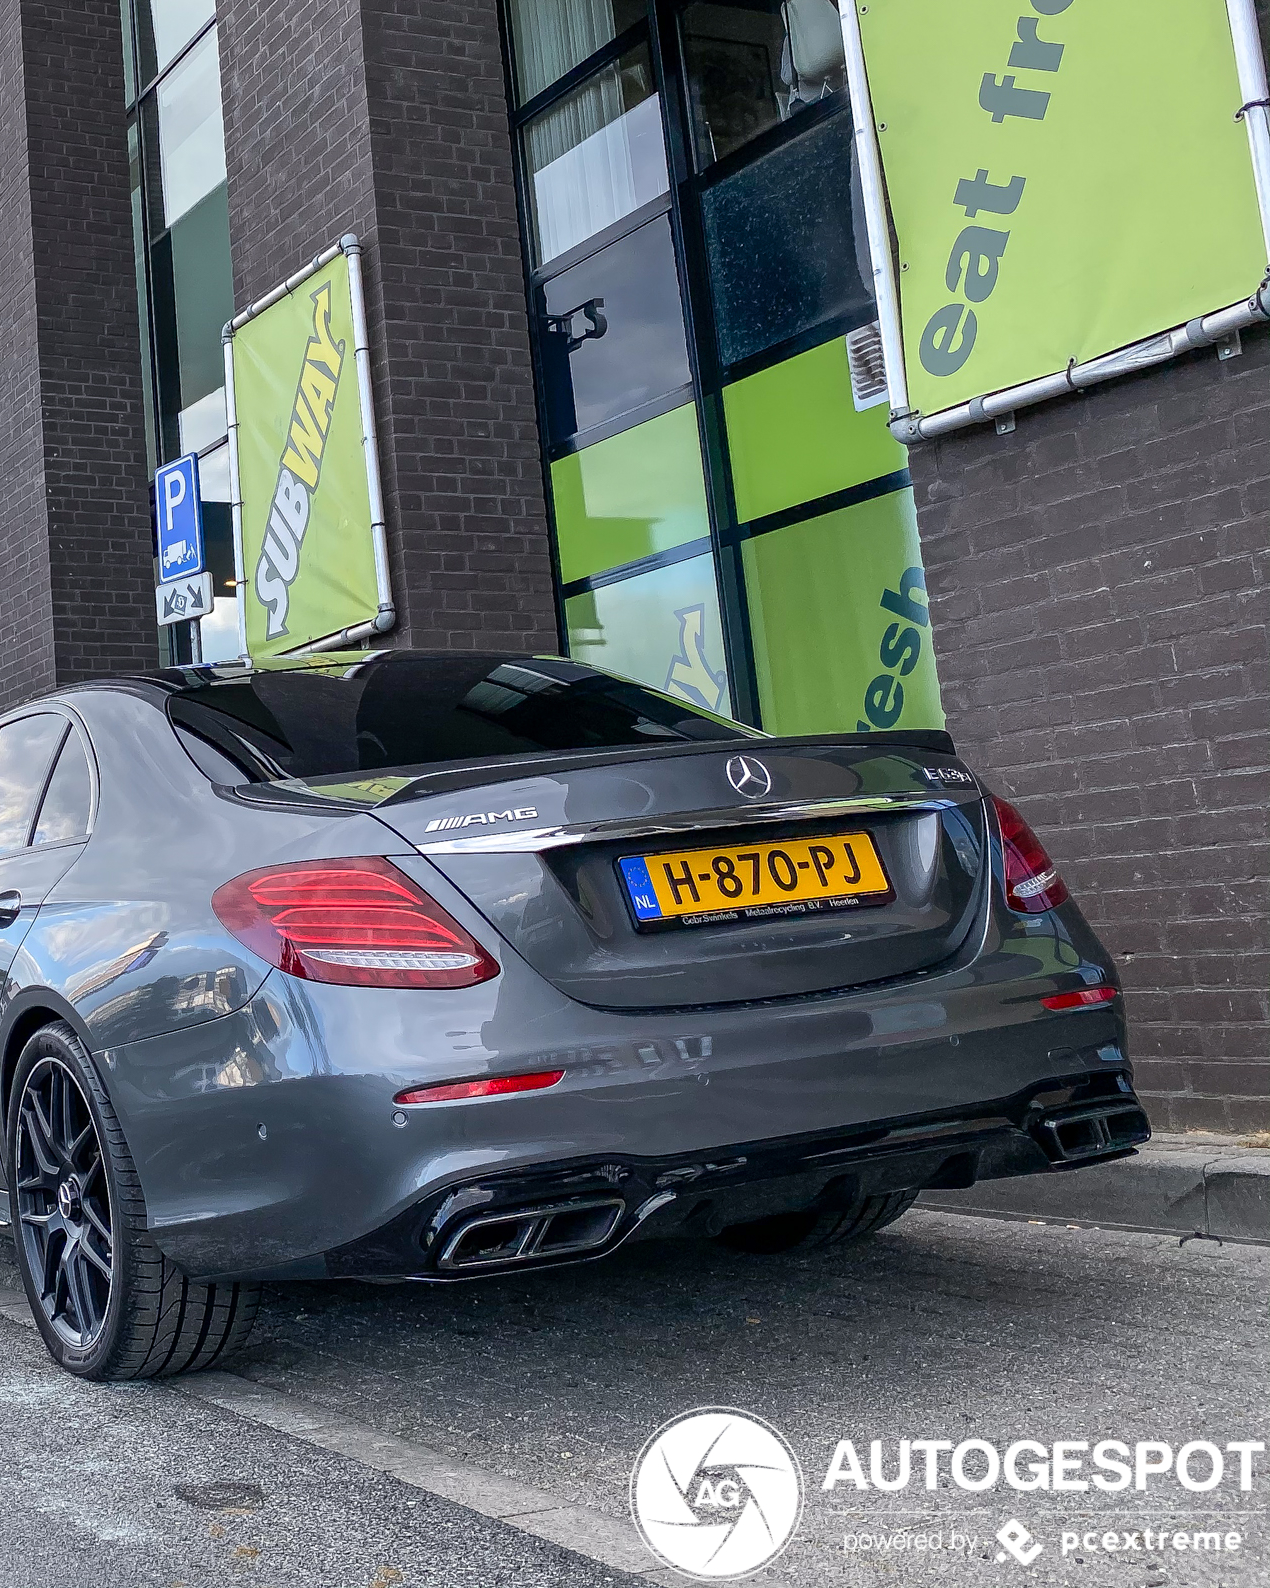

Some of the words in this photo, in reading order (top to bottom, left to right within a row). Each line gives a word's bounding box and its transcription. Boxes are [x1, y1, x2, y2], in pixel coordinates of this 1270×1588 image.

[919, 168, 1027, 377] eat
[978, 0, 1074, 124] fr
[255, 280, 346, 642] SUBWAY
[164, 469, 187, 531] P
[462, 806, 539, 828] AMG
[635, 894, 656, 909] NL
[663, 842, 862, 905] H-870-PJ
[829, 896, 860, 907] Heerlen
